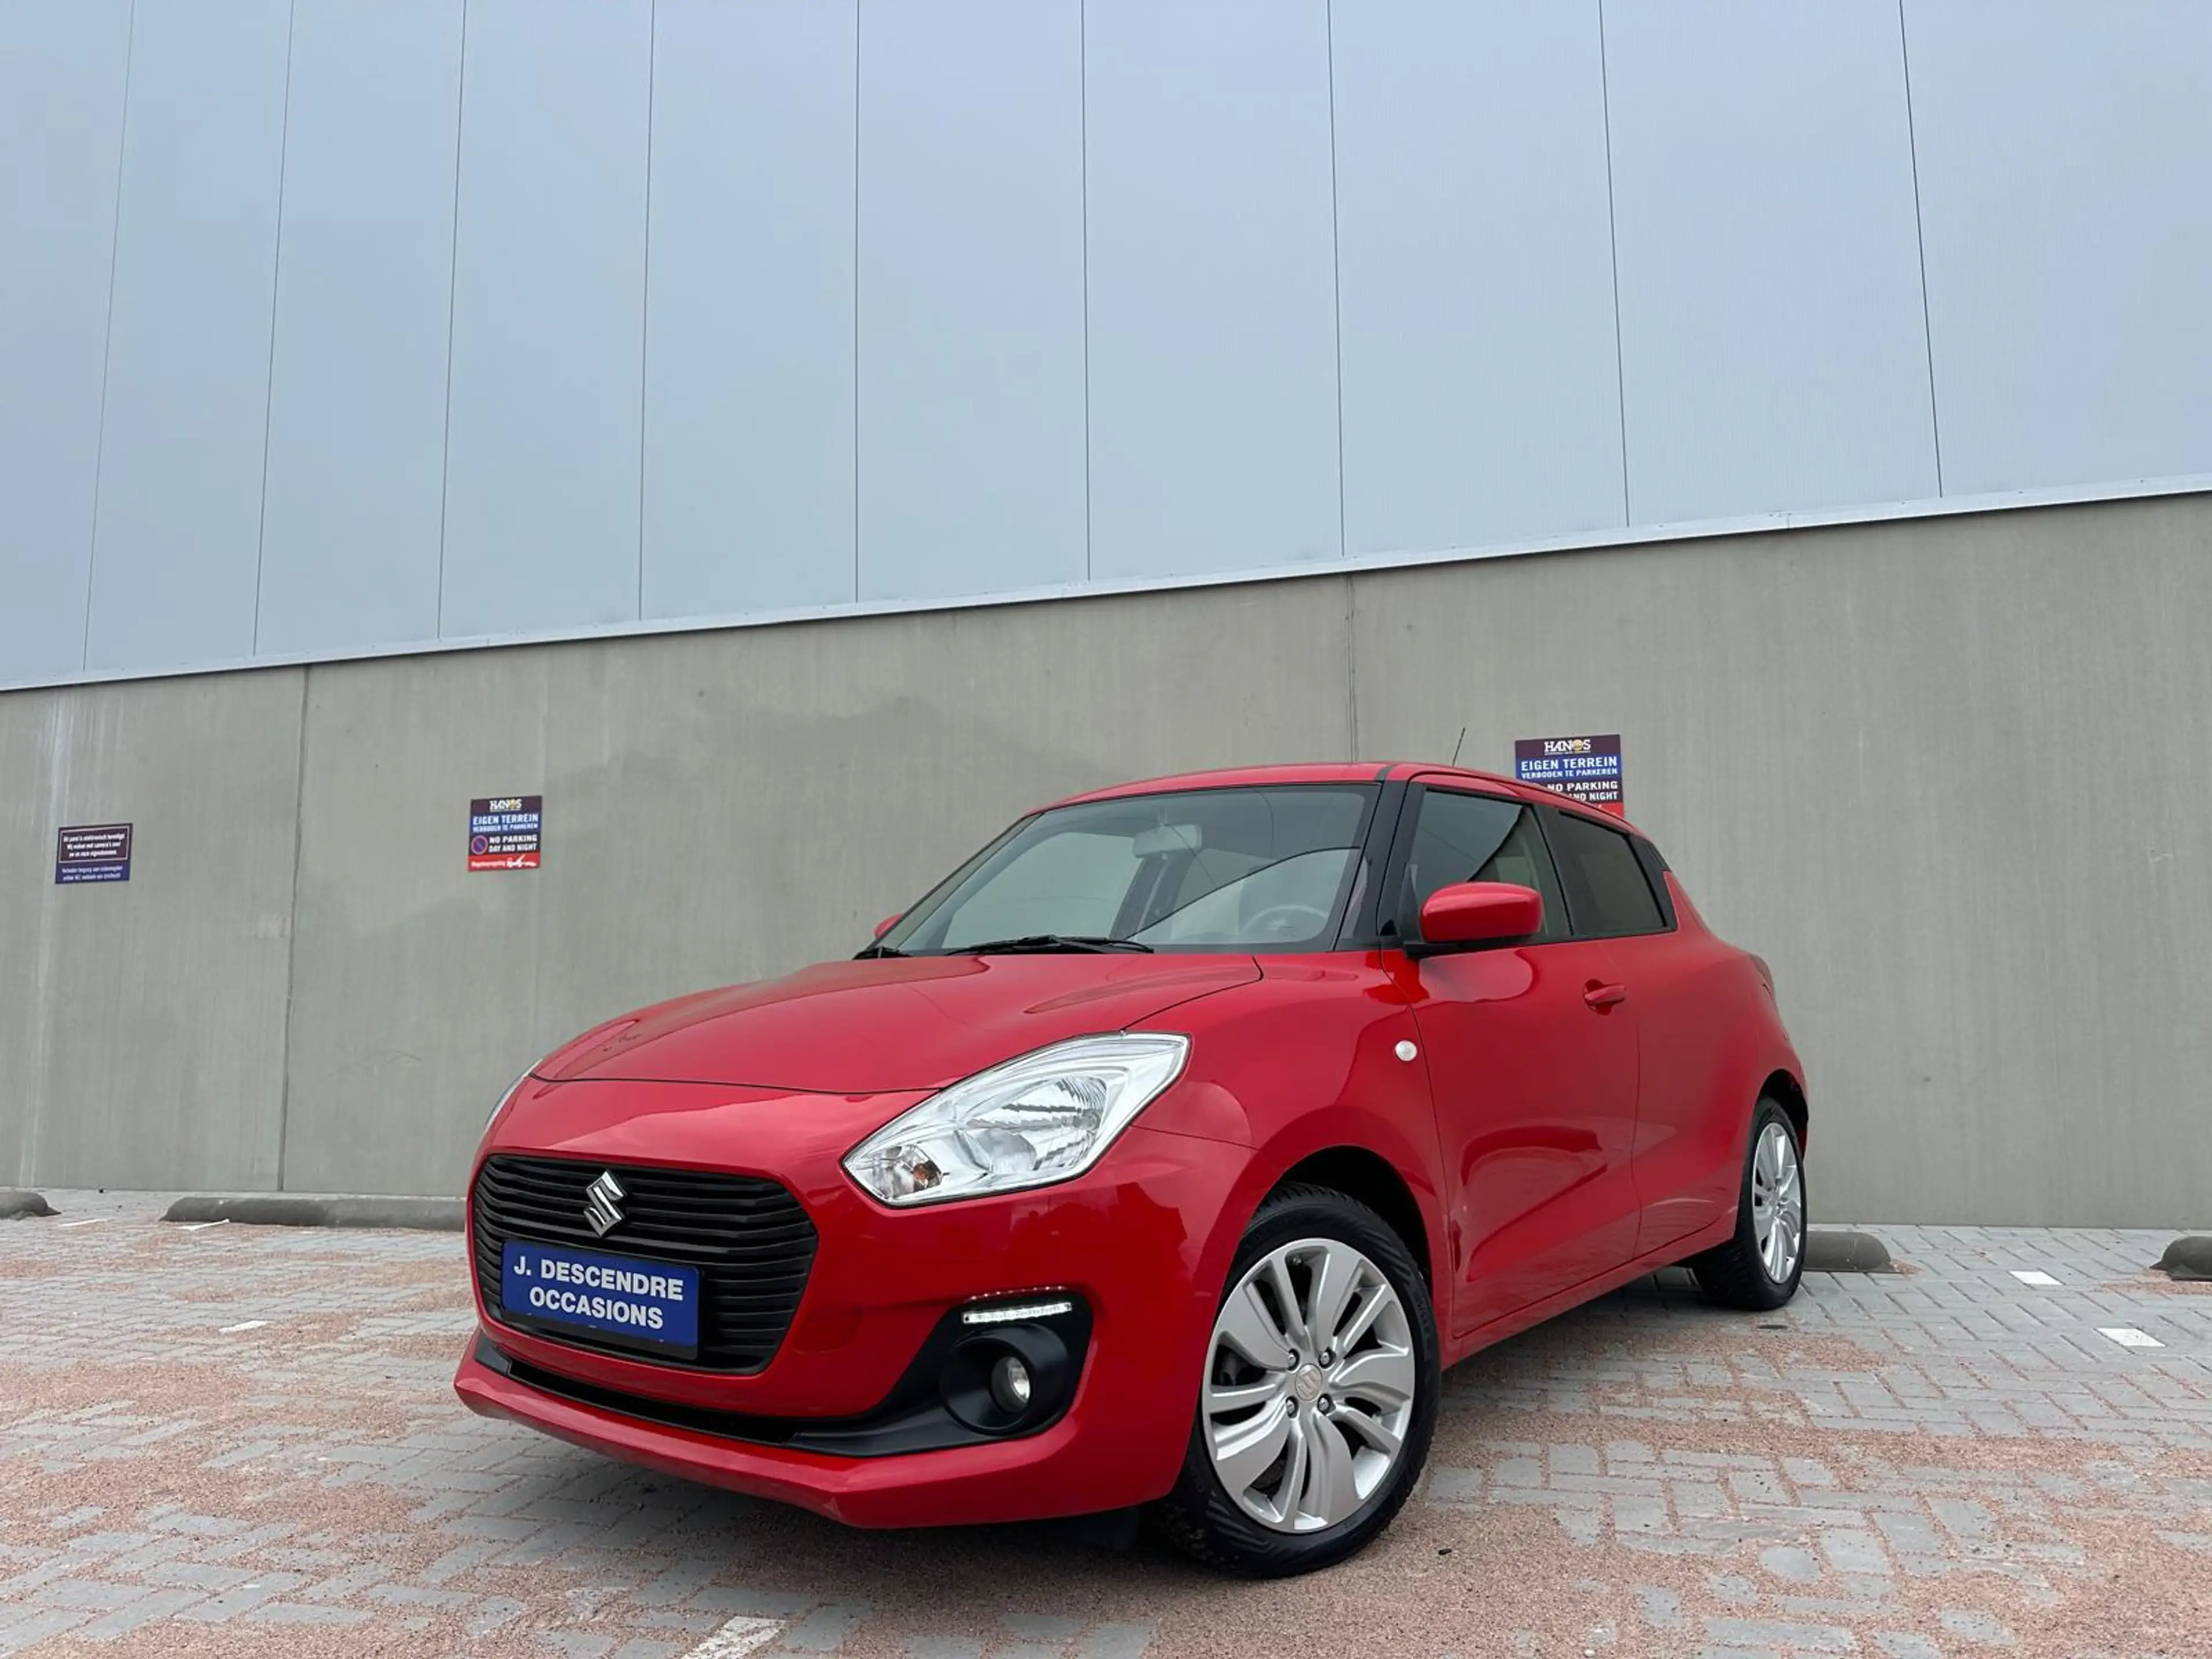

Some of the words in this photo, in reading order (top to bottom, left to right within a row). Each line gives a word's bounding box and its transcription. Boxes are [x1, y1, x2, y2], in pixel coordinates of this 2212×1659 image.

[1544, 739, 1591, 752] HANOS
[1521, 759, 1559, 771] EIGEN
[1563, 756, 1618, 768] TERREIN
[1521, 770, 1563, 779] VERBODEN
[1576, 768, 1618, 776] PARKEREN
[1567, 781, 1618, 791] PARKING
[1589, 792, 1618, 801] NIGHT
[474, 816, 499, 825] EIGEN
[501, 813, 539, 823] TERREIN
[502, 835, 537, 843] PARKING
[514, 1256, 532, 1276] J.
[541, 1259, 684, 1301] DESCENDRE
[529, 1286, 663, 1330] OCCASIONS
